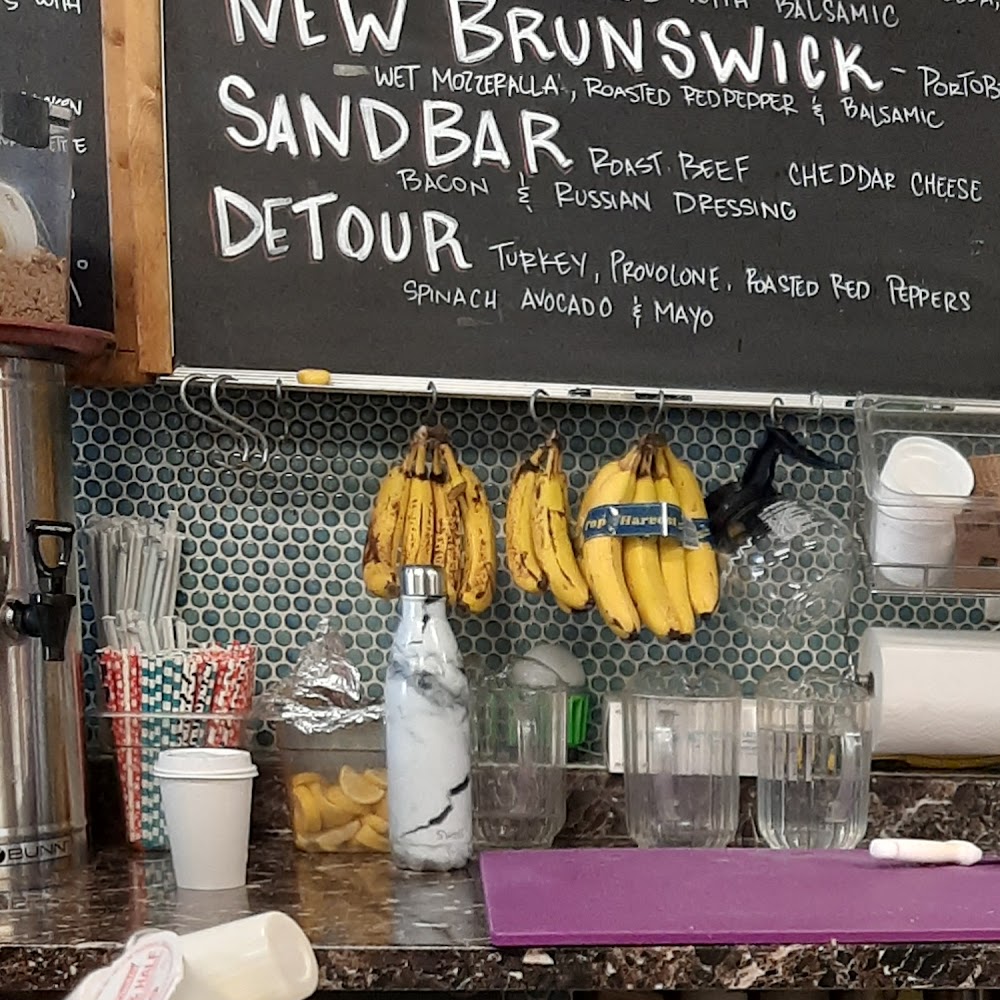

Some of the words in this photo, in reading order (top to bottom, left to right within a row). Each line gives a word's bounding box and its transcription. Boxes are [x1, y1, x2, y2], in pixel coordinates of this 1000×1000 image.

[775, 0, 899, 28] BALSAMIC
[229, 0, 407, 53] NEW
[448, 0, 883, 93] BRUNSWICK
[374, 64, 421, 91] WET
[582, 77, 671, 107] ROASTED
[839, 96, 945, 129] BALSAMIC
[216, 74, 574, 174] SANDBAR
[587, 147, 663, 177] ROAST
[678, 150, 750, 183] BEEF
[788, 162, 896, 191] CHEDDAR
[910, 171, 982, 202] CHEESE
[396, 168, 489, 197] BACON
[554, 181, 651, 212] RUSSIAN
[672, 191, 797, 221] DRESSING
[213, 185, 473, 273] DETOUR
[745, 267, 820, 298] ROASTED
[829, 273, 870, 300] RED
[885, 274, 971, 313] PEPPERS
[403, 279, 497, 310] SPINACH
[520, 287, 613, 318] AVOCADO
[653, 300, 714, 334] MAYO
[8, 841, 67, 860] BUNN
